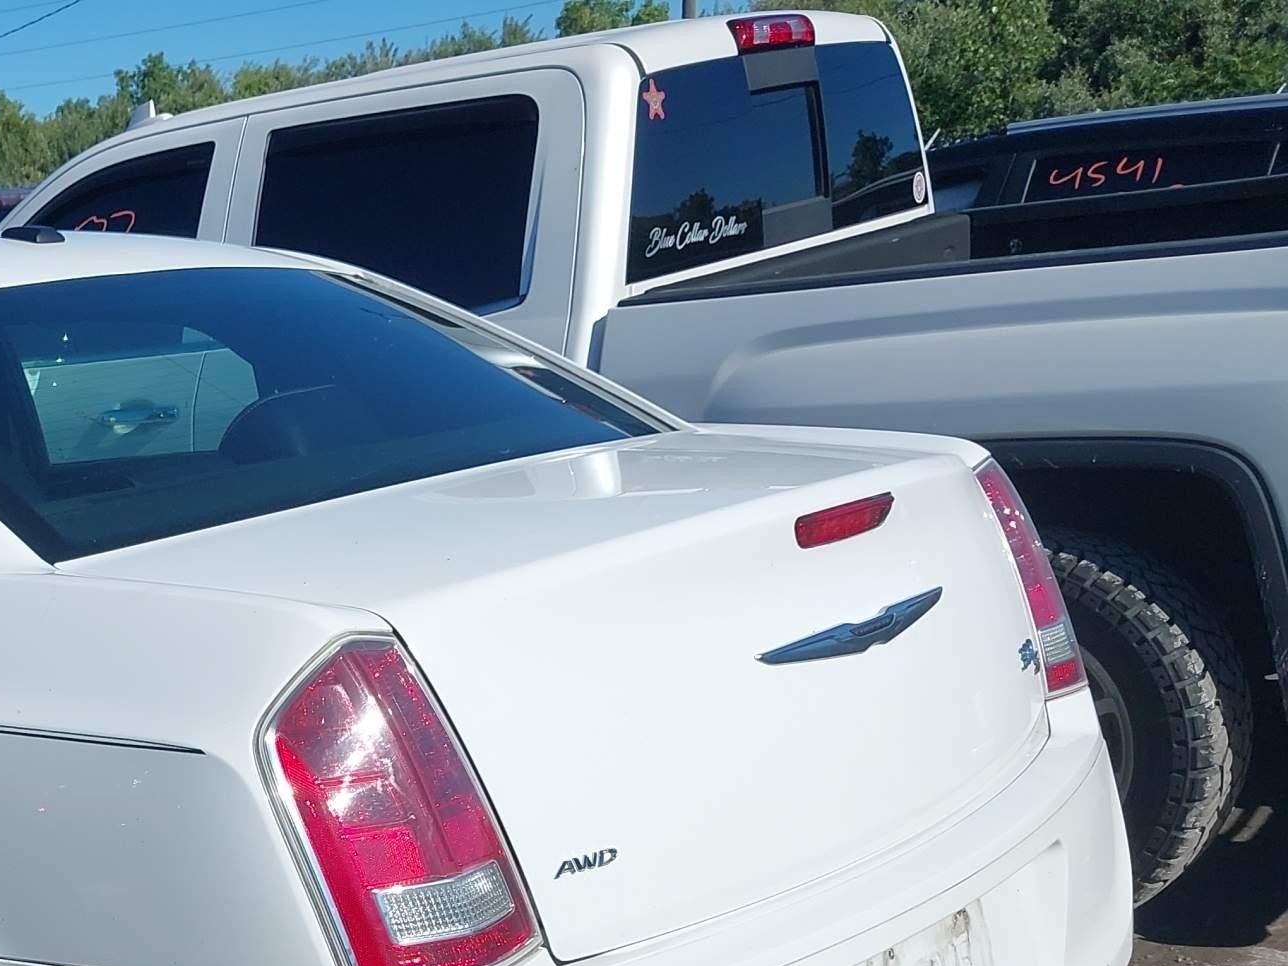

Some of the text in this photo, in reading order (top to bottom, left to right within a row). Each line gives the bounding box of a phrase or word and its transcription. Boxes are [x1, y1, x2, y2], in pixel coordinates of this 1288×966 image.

[1049, 156, 1163, 190] 4541
[645, 227, 675, 258] Blue
[676, 221, 709, 250] Collar
[553, 848, 618, 880] AWD
